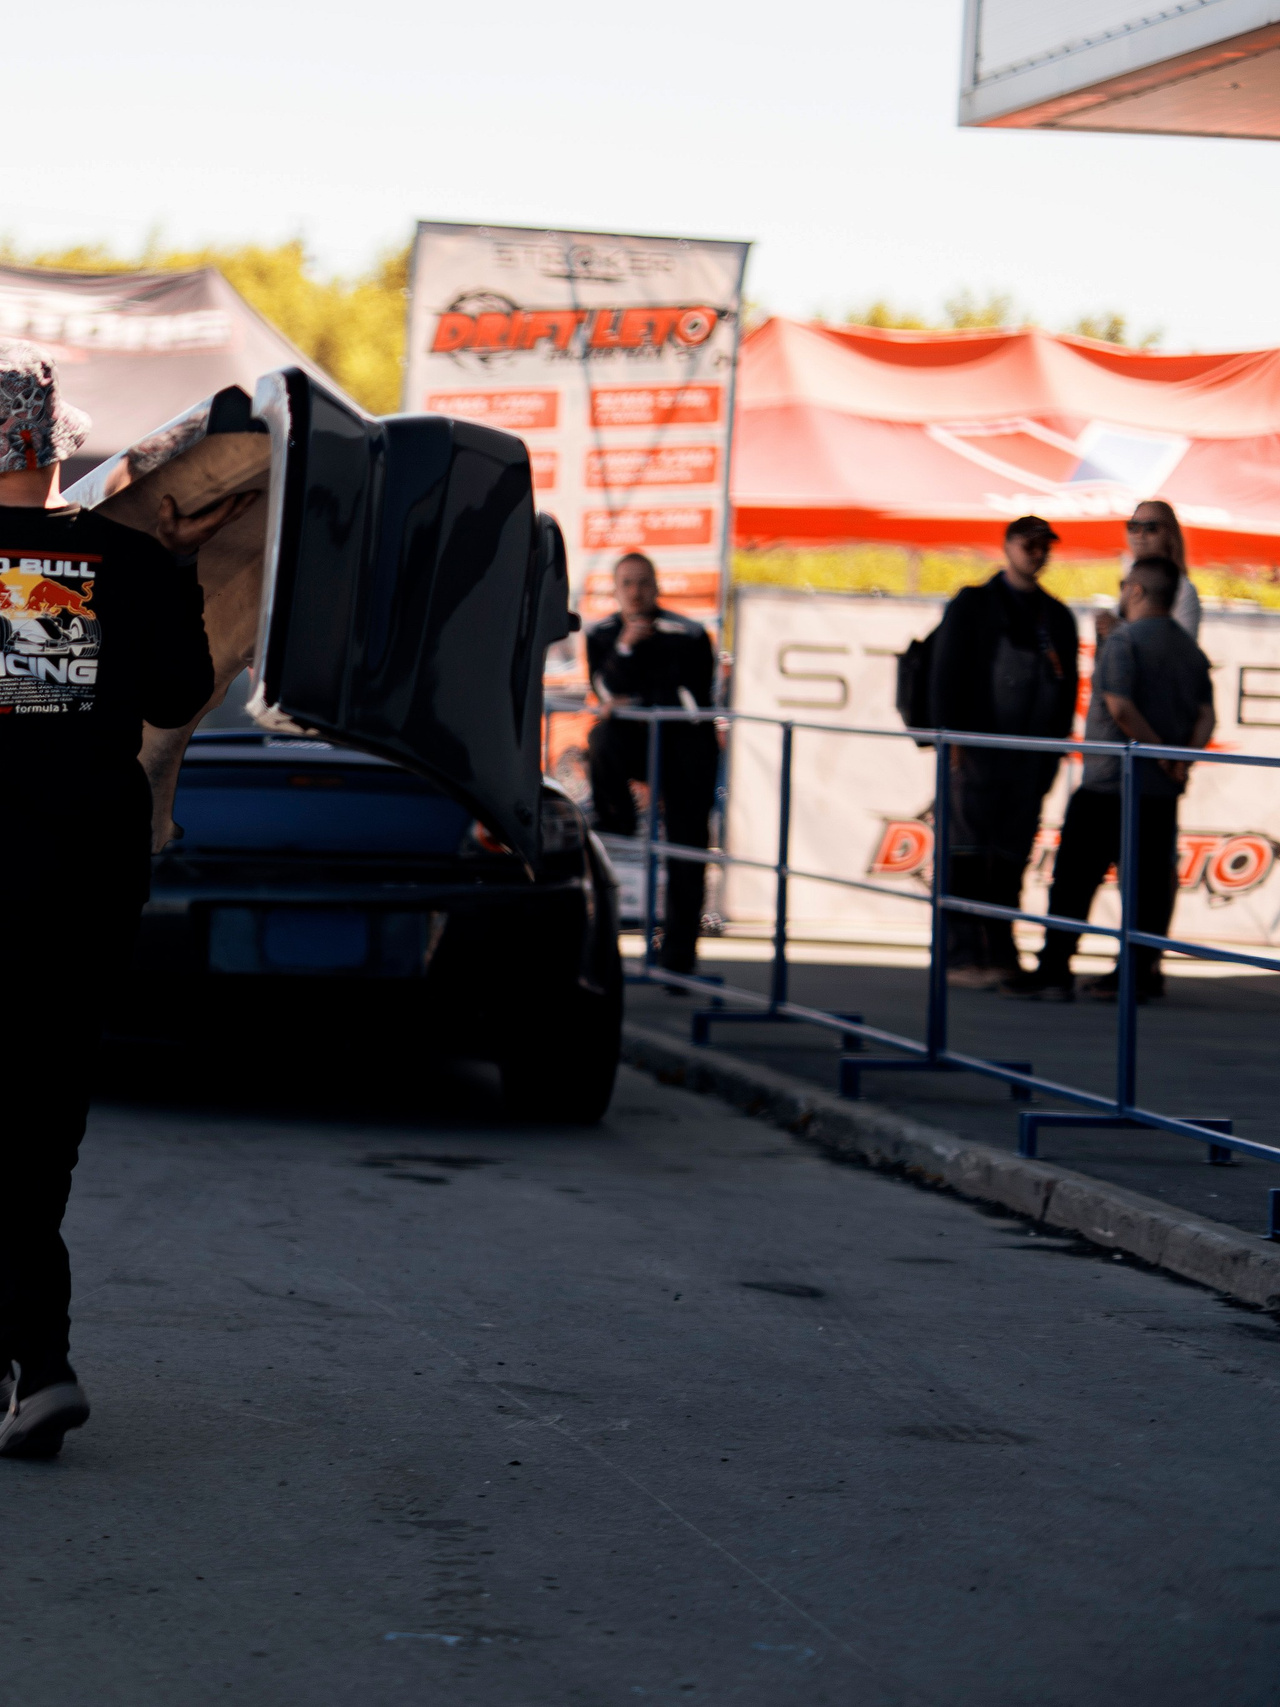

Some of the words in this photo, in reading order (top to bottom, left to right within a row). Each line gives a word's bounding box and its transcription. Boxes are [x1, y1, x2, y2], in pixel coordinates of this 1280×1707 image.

[431, 308, 587, 353] DRIFT
[588, 304, 719, 351] LETO
[20, 558, 96, 578] BULL
[15, 703, 60, 714] formula
[62, 703, 69, 713] 1
